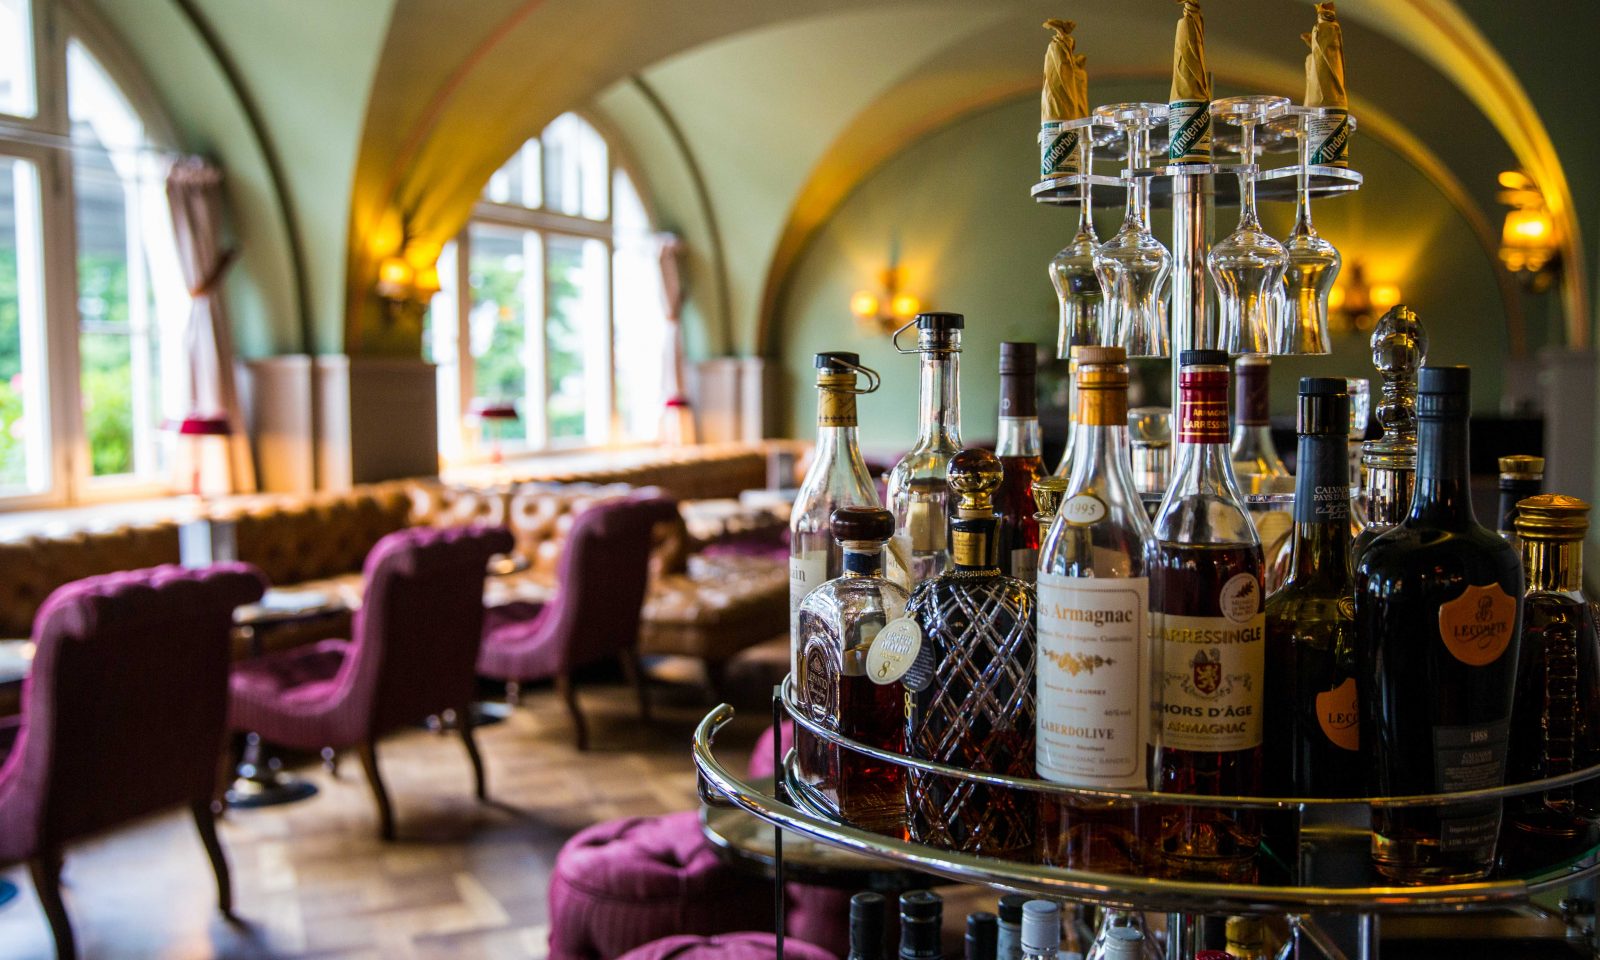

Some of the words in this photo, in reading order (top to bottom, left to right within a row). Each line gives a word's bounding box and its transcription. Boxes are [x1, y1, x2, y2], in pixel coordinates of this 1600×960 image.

[1068, 502, 1096, 515] 1995
[1052, 602, 1133, 627] Armagnac
[1163, 703, 1203, 717] HORS
[1041, 718, 1115, 740] LABERDOLIVE
[1167, 721, 1246, 734] ARMAGNAC
